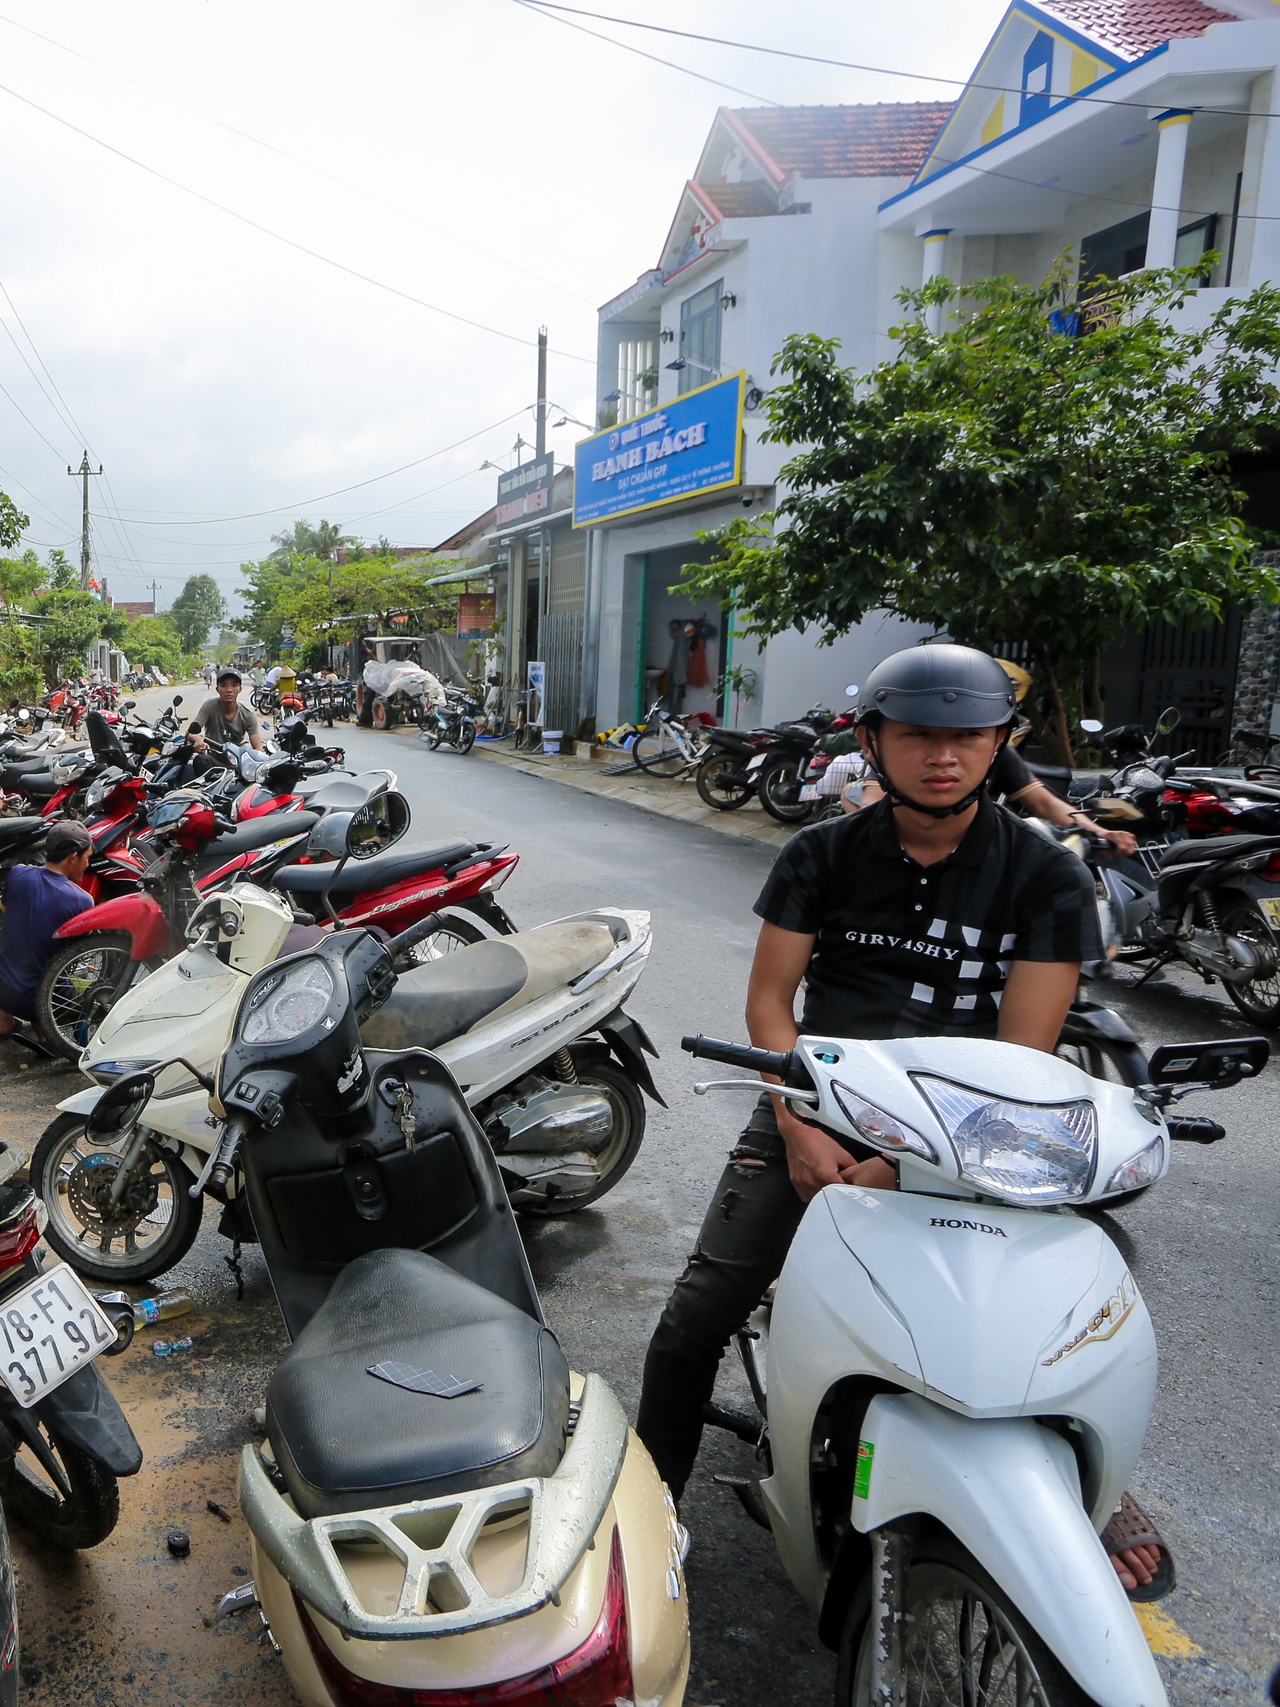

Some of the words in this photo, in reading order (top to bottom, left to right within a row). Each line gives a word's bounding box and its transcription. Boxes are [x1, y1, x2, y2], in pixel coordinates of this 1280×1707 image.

[592, 446, 645, 482] HẠNH
[645, 422, 707, 463] BÁCH
[653, 463, 668, 480] GPP
[845, 930, 960, 961] GIRVASHY
[929, 1216, 1009, 1239] HONDA
[8, 1308, 109, 1396] 377.92
